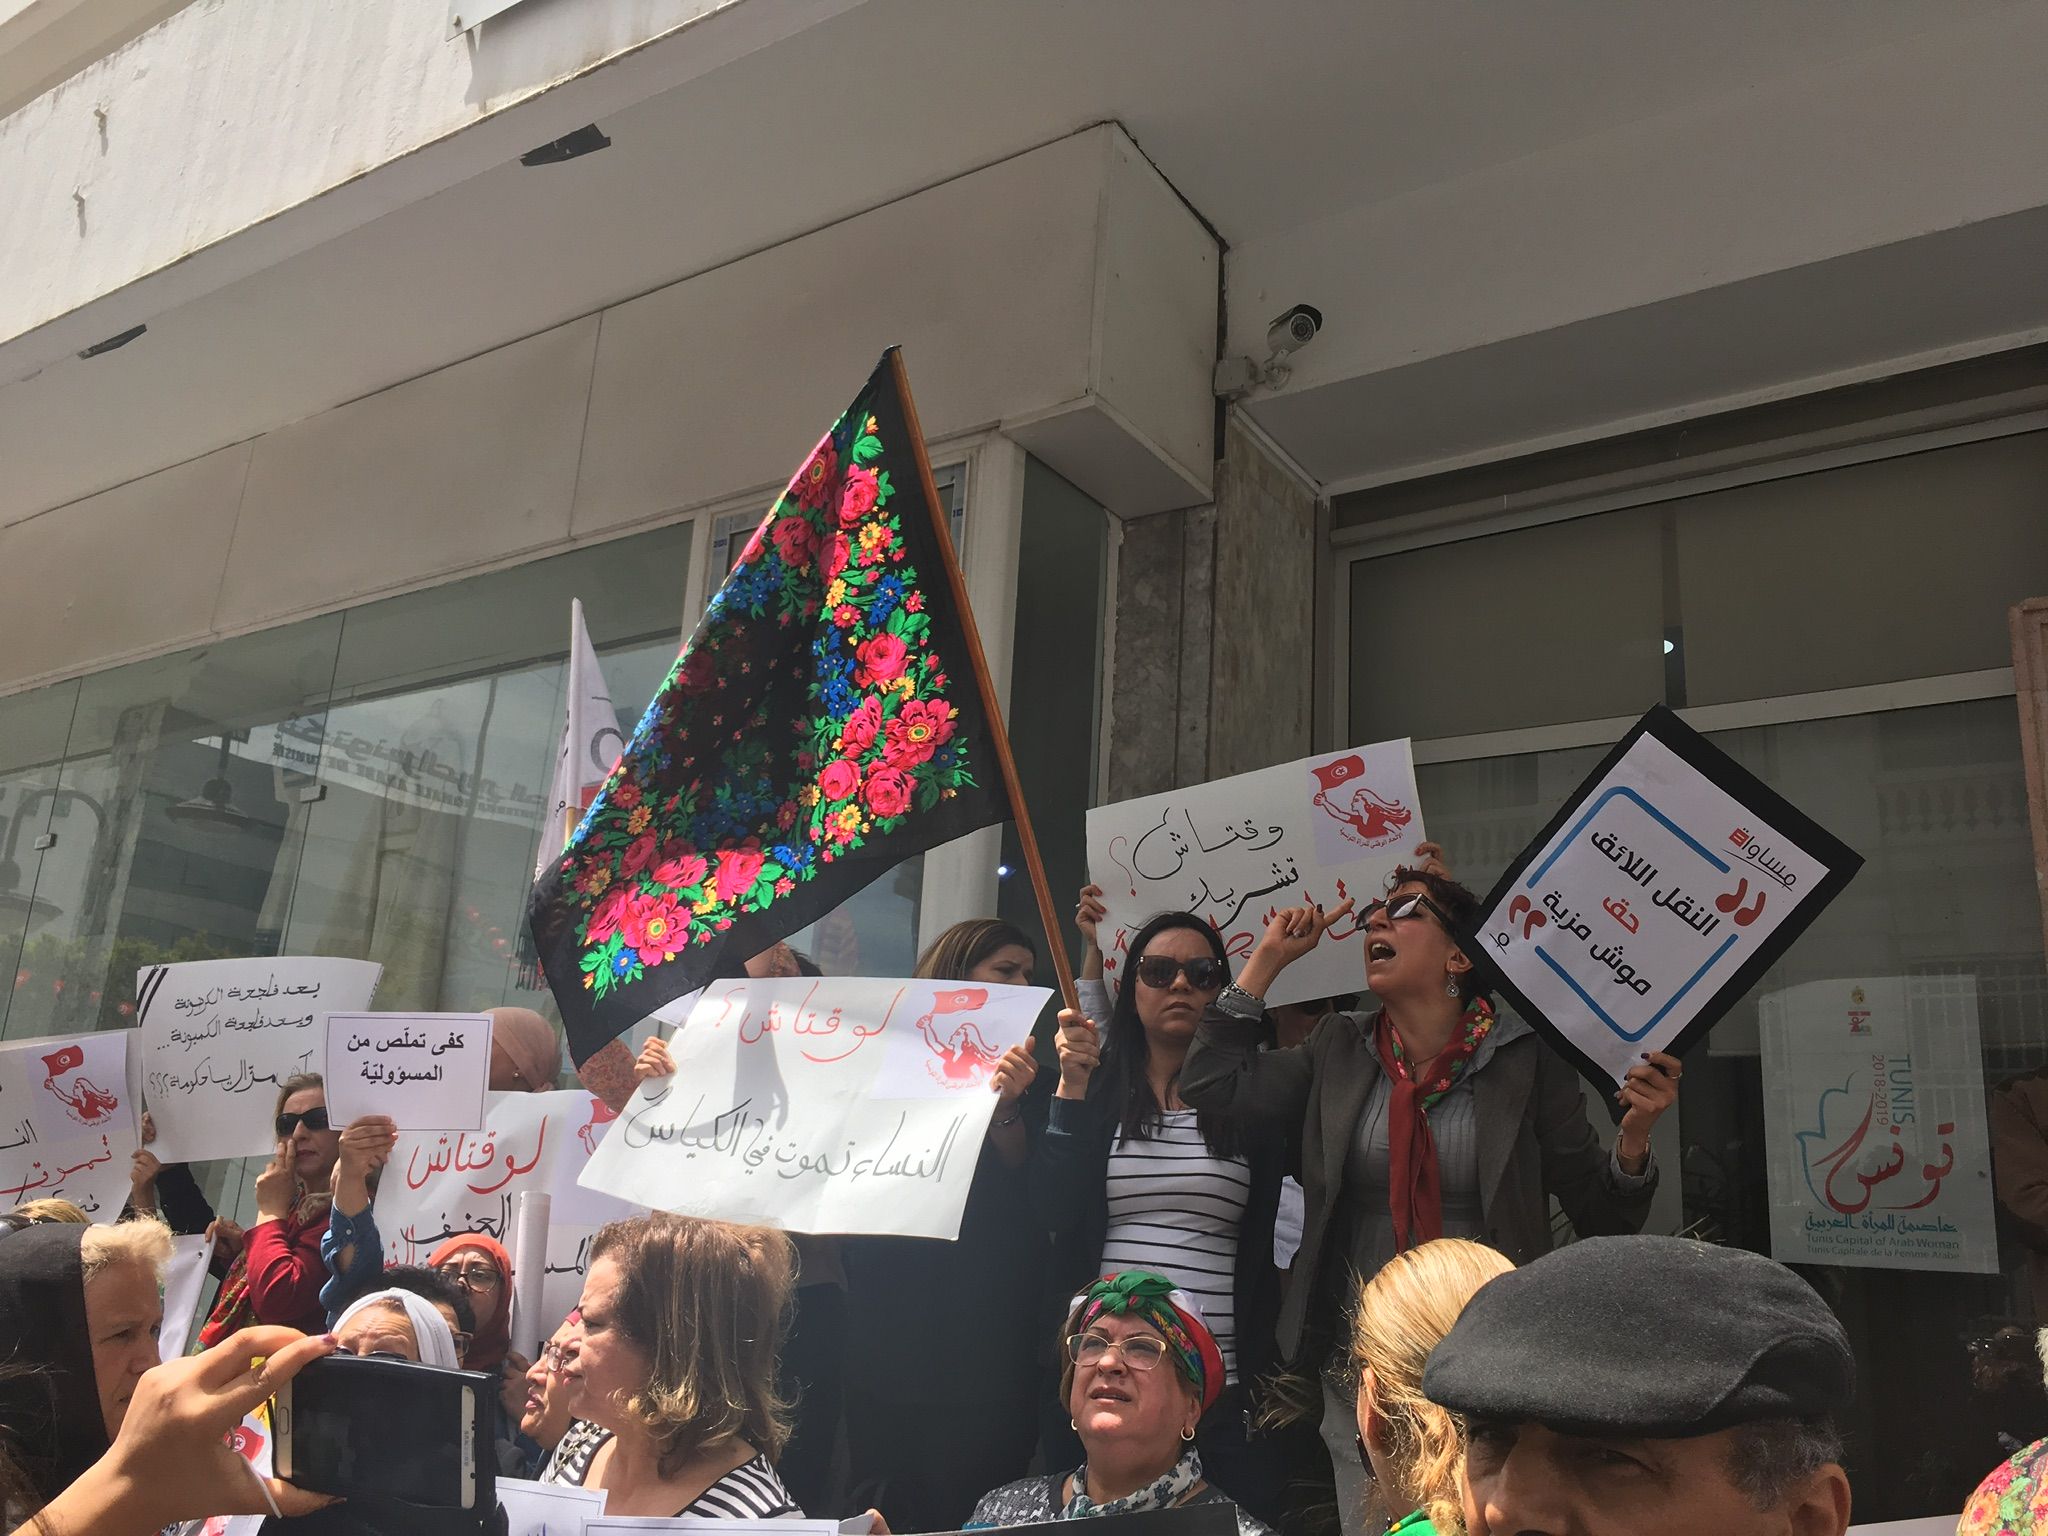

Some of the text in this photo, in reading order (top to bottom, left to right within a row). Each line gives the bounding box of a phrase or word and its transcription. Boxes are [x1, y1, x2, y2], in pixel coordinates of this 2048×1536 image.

[1591, 831, 1721, 937] النقل اللائق
[1729, 827, 1797, 887] مساواة
[1543, 890, 1652, 996] موش مزية
[1602, 896, 1640, 935] حق
[347, 1034, 370, 1051] من
[431, 1032, 464, 1055] كفى
[1872, 1055, 1889, 1126] 2018-2019
[1889, 1054, 1916, 1125] TUNIS
[775, 1140, 855, 1180] تموت
[853, 1111, 967, 1183] النساء
[1811, 1122, 1955, 1214] تونس
[400, 1192, 512, 1244] العنف
[1807, 1234, 1960, 1249] Tunis Capital of Arab Woman
